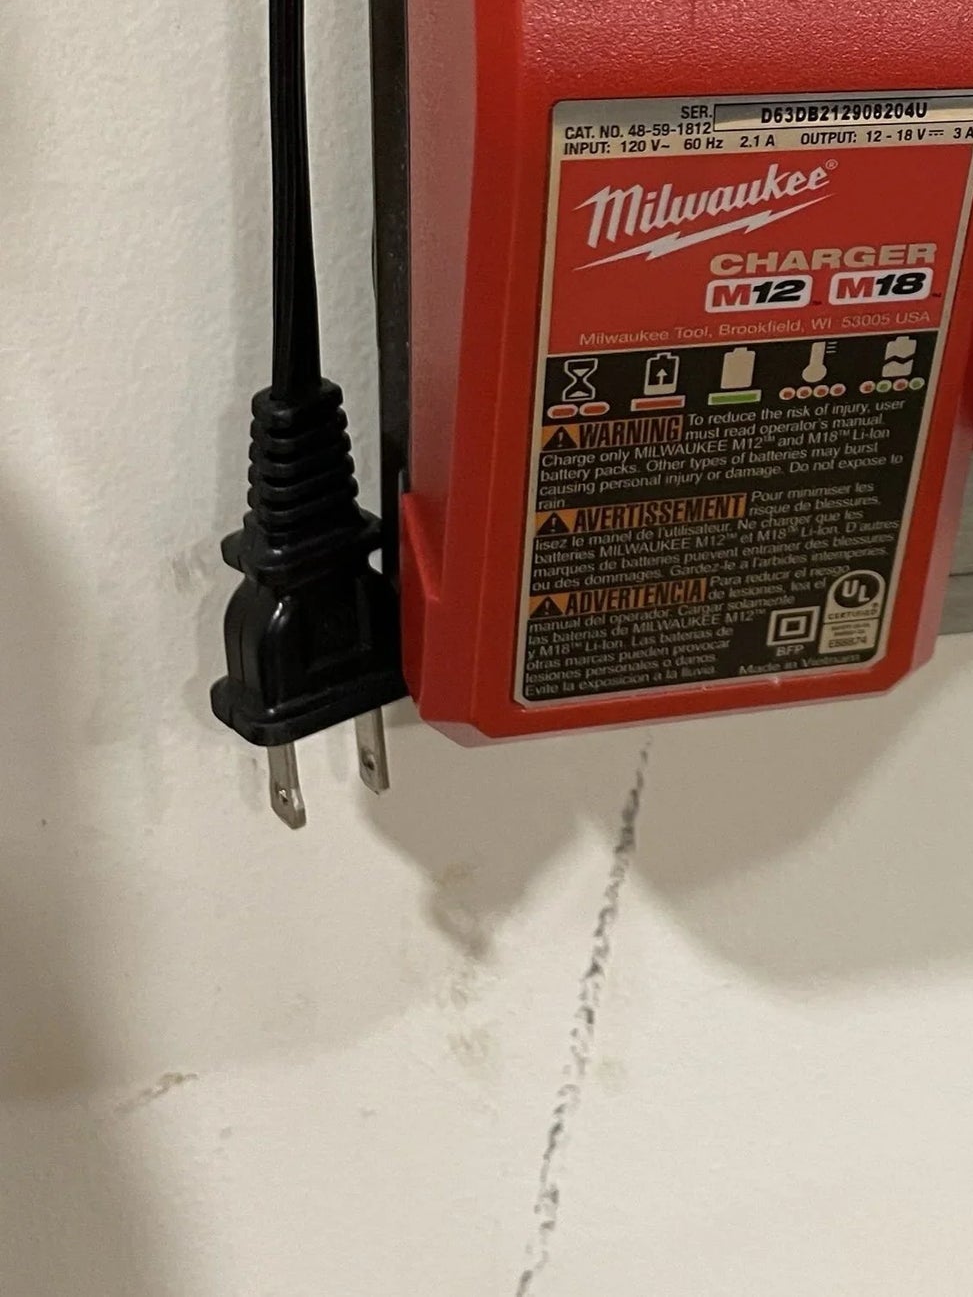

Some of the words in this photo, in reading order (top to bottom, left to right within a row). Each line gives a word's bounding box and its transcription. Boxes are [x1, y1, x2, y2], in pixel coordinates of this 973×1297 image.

[681, 106, 712, 119] SER.
[761, 102, 928, 123] D63DB212908204U
[564, 141, 610, 155] INPUT:
[621, 140, 646, 153] 120
[684, 138, 700, 150] 60
[706, 137, 723, 149] Hz
[740, 136, 760, 148] 2.1
[765, 134, 775, 147] A
[801, 132, 857, 145] OUTPUT:
[866, 131, 881, 143] 12
[898, 129, 912, 141] 18
[953, 127, 962, 139] 3
[565, 126, 595, 139] CAT.
[600, 125, 624, 138] NO.
[628, 122, 711, 137] 48-59-1812
[710, 243, 938, 276] CHARGER
[579, 330, 669, 346] Milwaukee
[674, 326, 712, 339] Tool,
[719, 318, 805, 336] Brookfield,
[811, 317, 831, 330] WI
[842, 314, 890, 327] 53005
[896, 311, 930, 323] USA
[688, 414, 703, 425] To
[708, 410, 756, 424] reduce
[761, 408, 782, 419] the
[787, 405, 810, 418] risk
[815, 403, 828, 416] of
[832, 402, 871, 417] injury,
[876, 399, 905, 411] user
[578, 416, 681, 448] WARNING
[685, 428, 719, 440] must
[724, 423, 755, 437] read
[760, 418, 828, 437] operator's
[540, 468, 592, 482] battery
[647, 459, 685, 471] Other
[691, 455, 727, 468] types
[731, 453, 745, 464] of
[749, 448, 807, 463] batteries
[811, 444, 840, 458] may
[844, 442, 878, 454] burst
[542, 453, 595, 468] Charge
[600, 449, 630, 463] only
[635, 440, 727, 459] MILWAUKEE
[778, 434, 803, 447] and
[853, 428, 890, 440] Li-Ion
[539, 481, 595, 496] causing
[600, 474, 661, 493] personal
[666, 472, 702, 488] injury
[707, 470, 722, 480] or
[789, 461, 809, 473] Do
[813, 459, 834, 471] not
[839, 455, 887, 469] expose
[891, 453, 903, 464] to
[751, 490, 784, 502] Pour
[787, 484, 851, 499] minimiser
[855, 482, 875, 492] les
[573, 494, 746, 532] AVERTISSEMENT
[566, 579, 703, 615] ADVERTENCIA
[842, 580, 870, 602] UL
